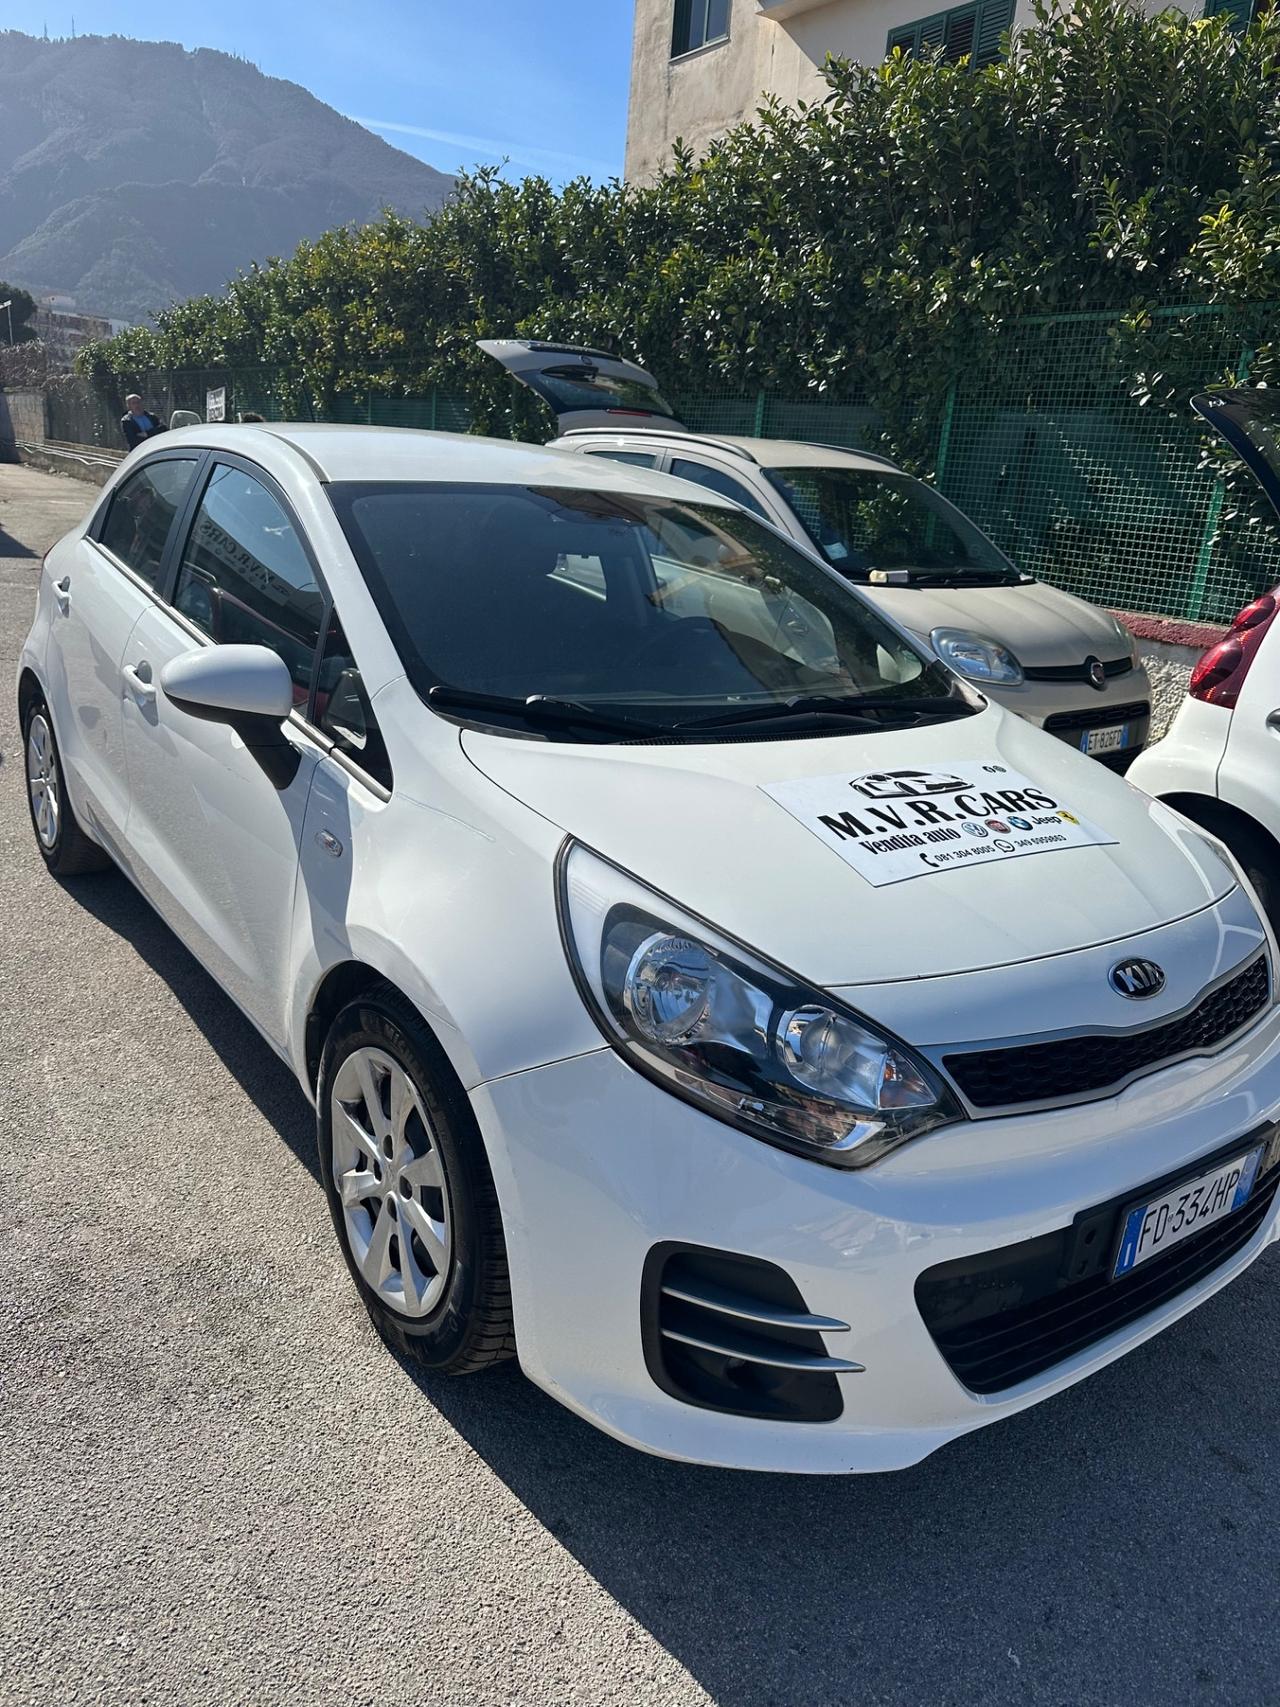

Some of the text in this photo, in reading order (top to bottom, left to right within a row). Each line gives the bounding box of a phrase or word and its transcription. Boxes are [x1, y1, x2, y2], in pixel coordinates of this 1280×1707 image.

[1032, 815, 1062, 825] Jeep
[858, 828, 962, 855] Vendita auto
[934, 853, 955, 862] 081
[953, 850, 973, 859] 304
[1116, 962, 1163, 992] KIA
